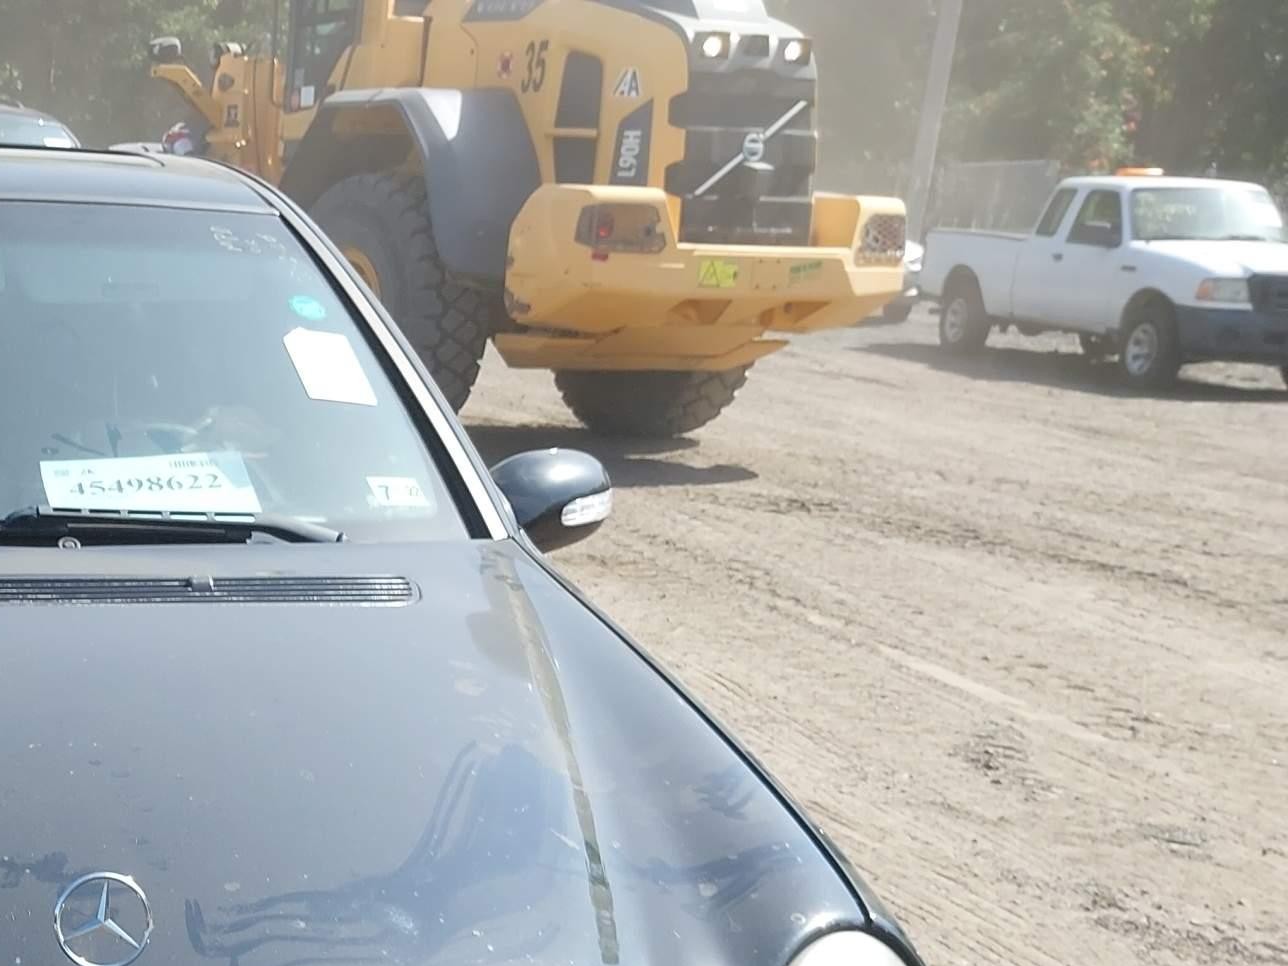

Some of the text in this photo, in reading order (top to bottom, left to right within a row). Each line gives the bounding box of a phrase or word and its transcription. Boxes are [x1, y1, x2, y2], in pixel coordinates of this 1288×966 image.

[520, 39, 550, 93] 35
[616, 129, 643, 177] L90H
[69, 473, 222, 495] 45498622
